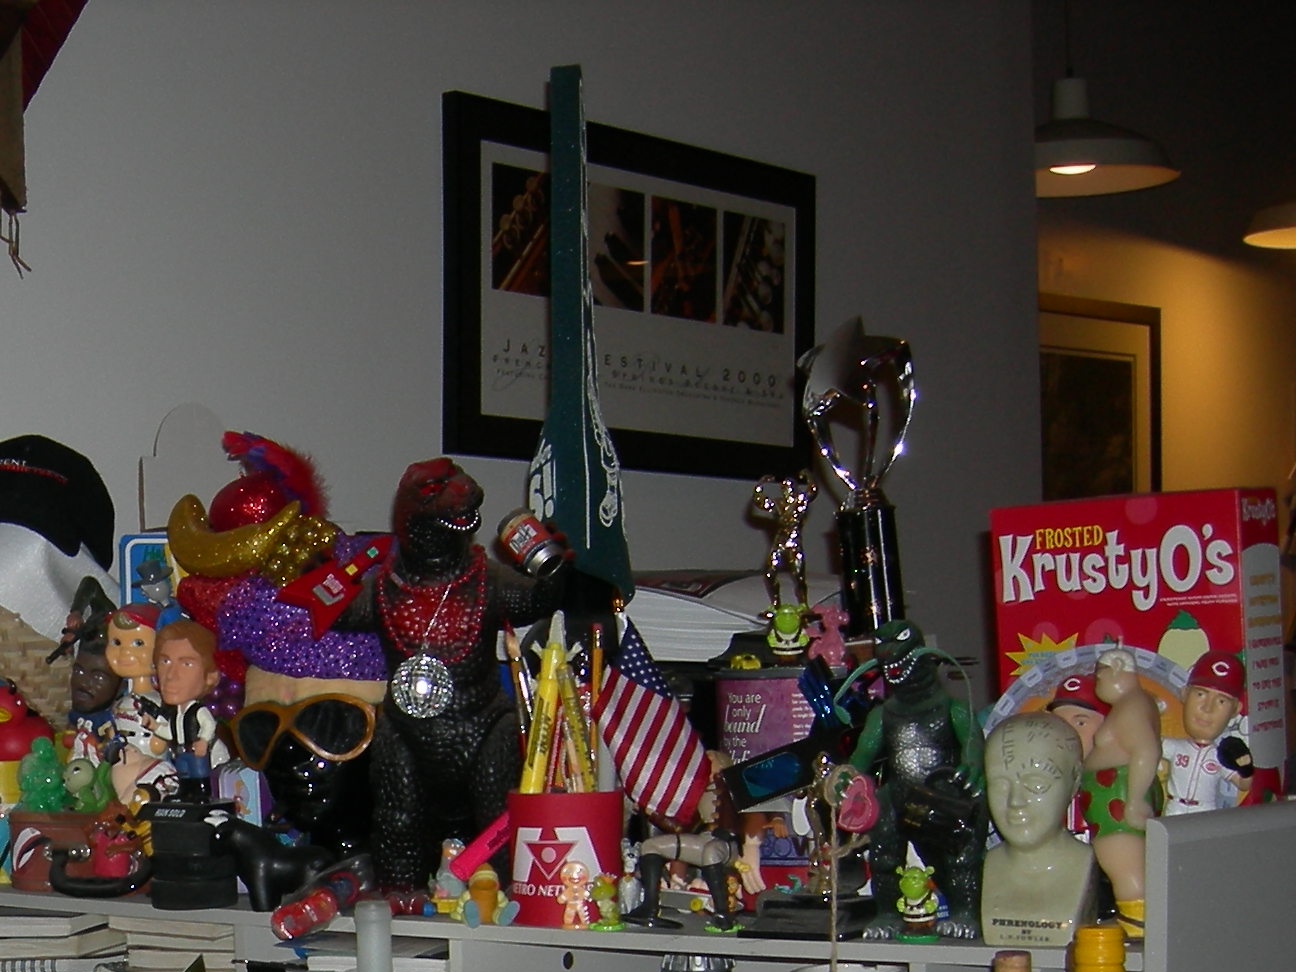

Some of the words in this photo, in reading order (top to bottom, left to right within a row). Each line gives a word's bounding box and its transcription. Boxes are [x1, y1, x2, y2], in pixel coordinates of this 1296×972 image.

[502, 338, 546, 358] JAZ
[604, 354, 704, 378] ESTIVAL
[722, 367, 777, 388] 2000
[1035, 525, 1103, 550] FROSTED
[998, 523, 1235, 611] KrustyO's
[1211, 661, 1230, 676] C
[1063, 677, 1081, 691] C
[744, 693, 762, 704] are
[731, 706, 753, 719] only
[732, 737, 748, 748] the
[168, 809, 186, 819] SOLO
[991, 918, 1063, 930] PHRENOLOGY
